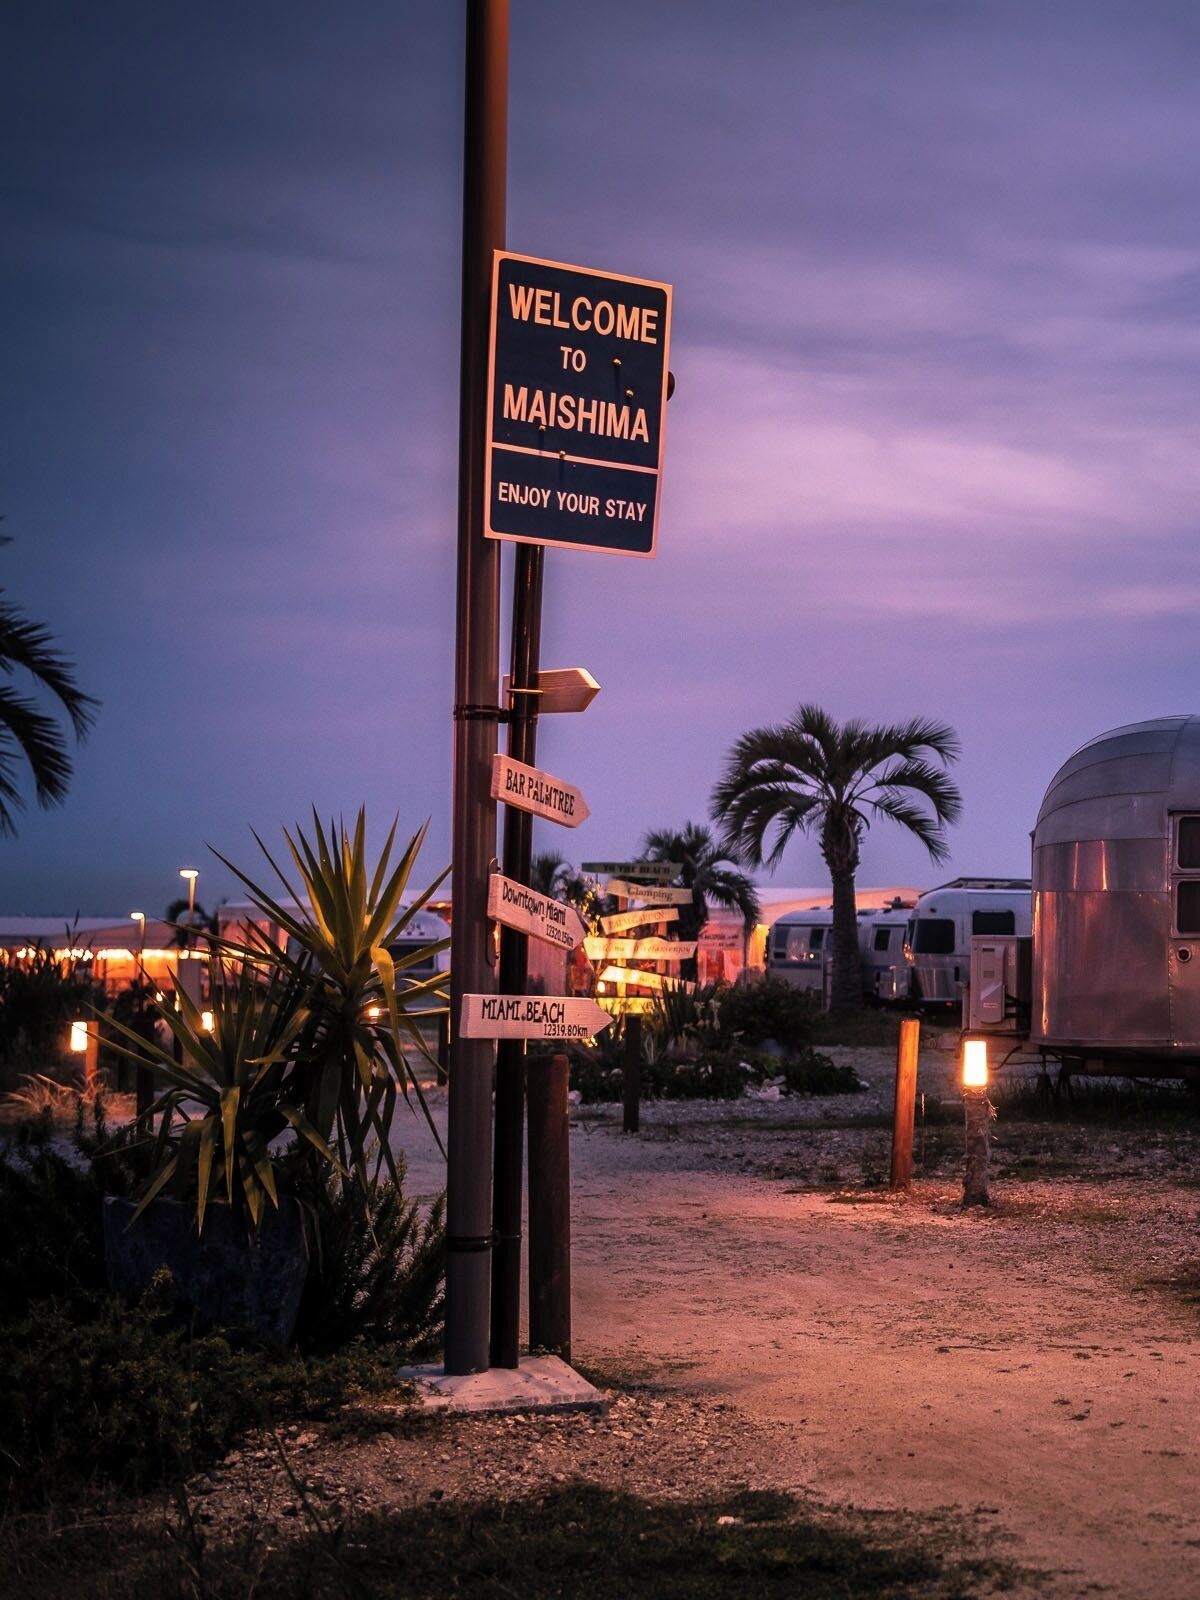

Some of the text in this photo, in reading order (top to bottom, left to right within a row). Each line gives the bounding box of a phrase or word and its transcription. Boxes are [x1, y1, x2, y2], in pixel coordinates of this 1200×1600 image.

[508, 283, 659, 345] WELCOME
[560, 345, 587, 373] TO
[502, 383, 650, 443] MAISHIMA
[498, 481, 647, 523] ENJOY YOUR STAY
[505, 768, 526, 797] BAR
[502, 881, 567, 926] Downtown Miami
[627, 886, 674, 901] Glamping
[543, 1023, 588, 1037] 12319.80km
